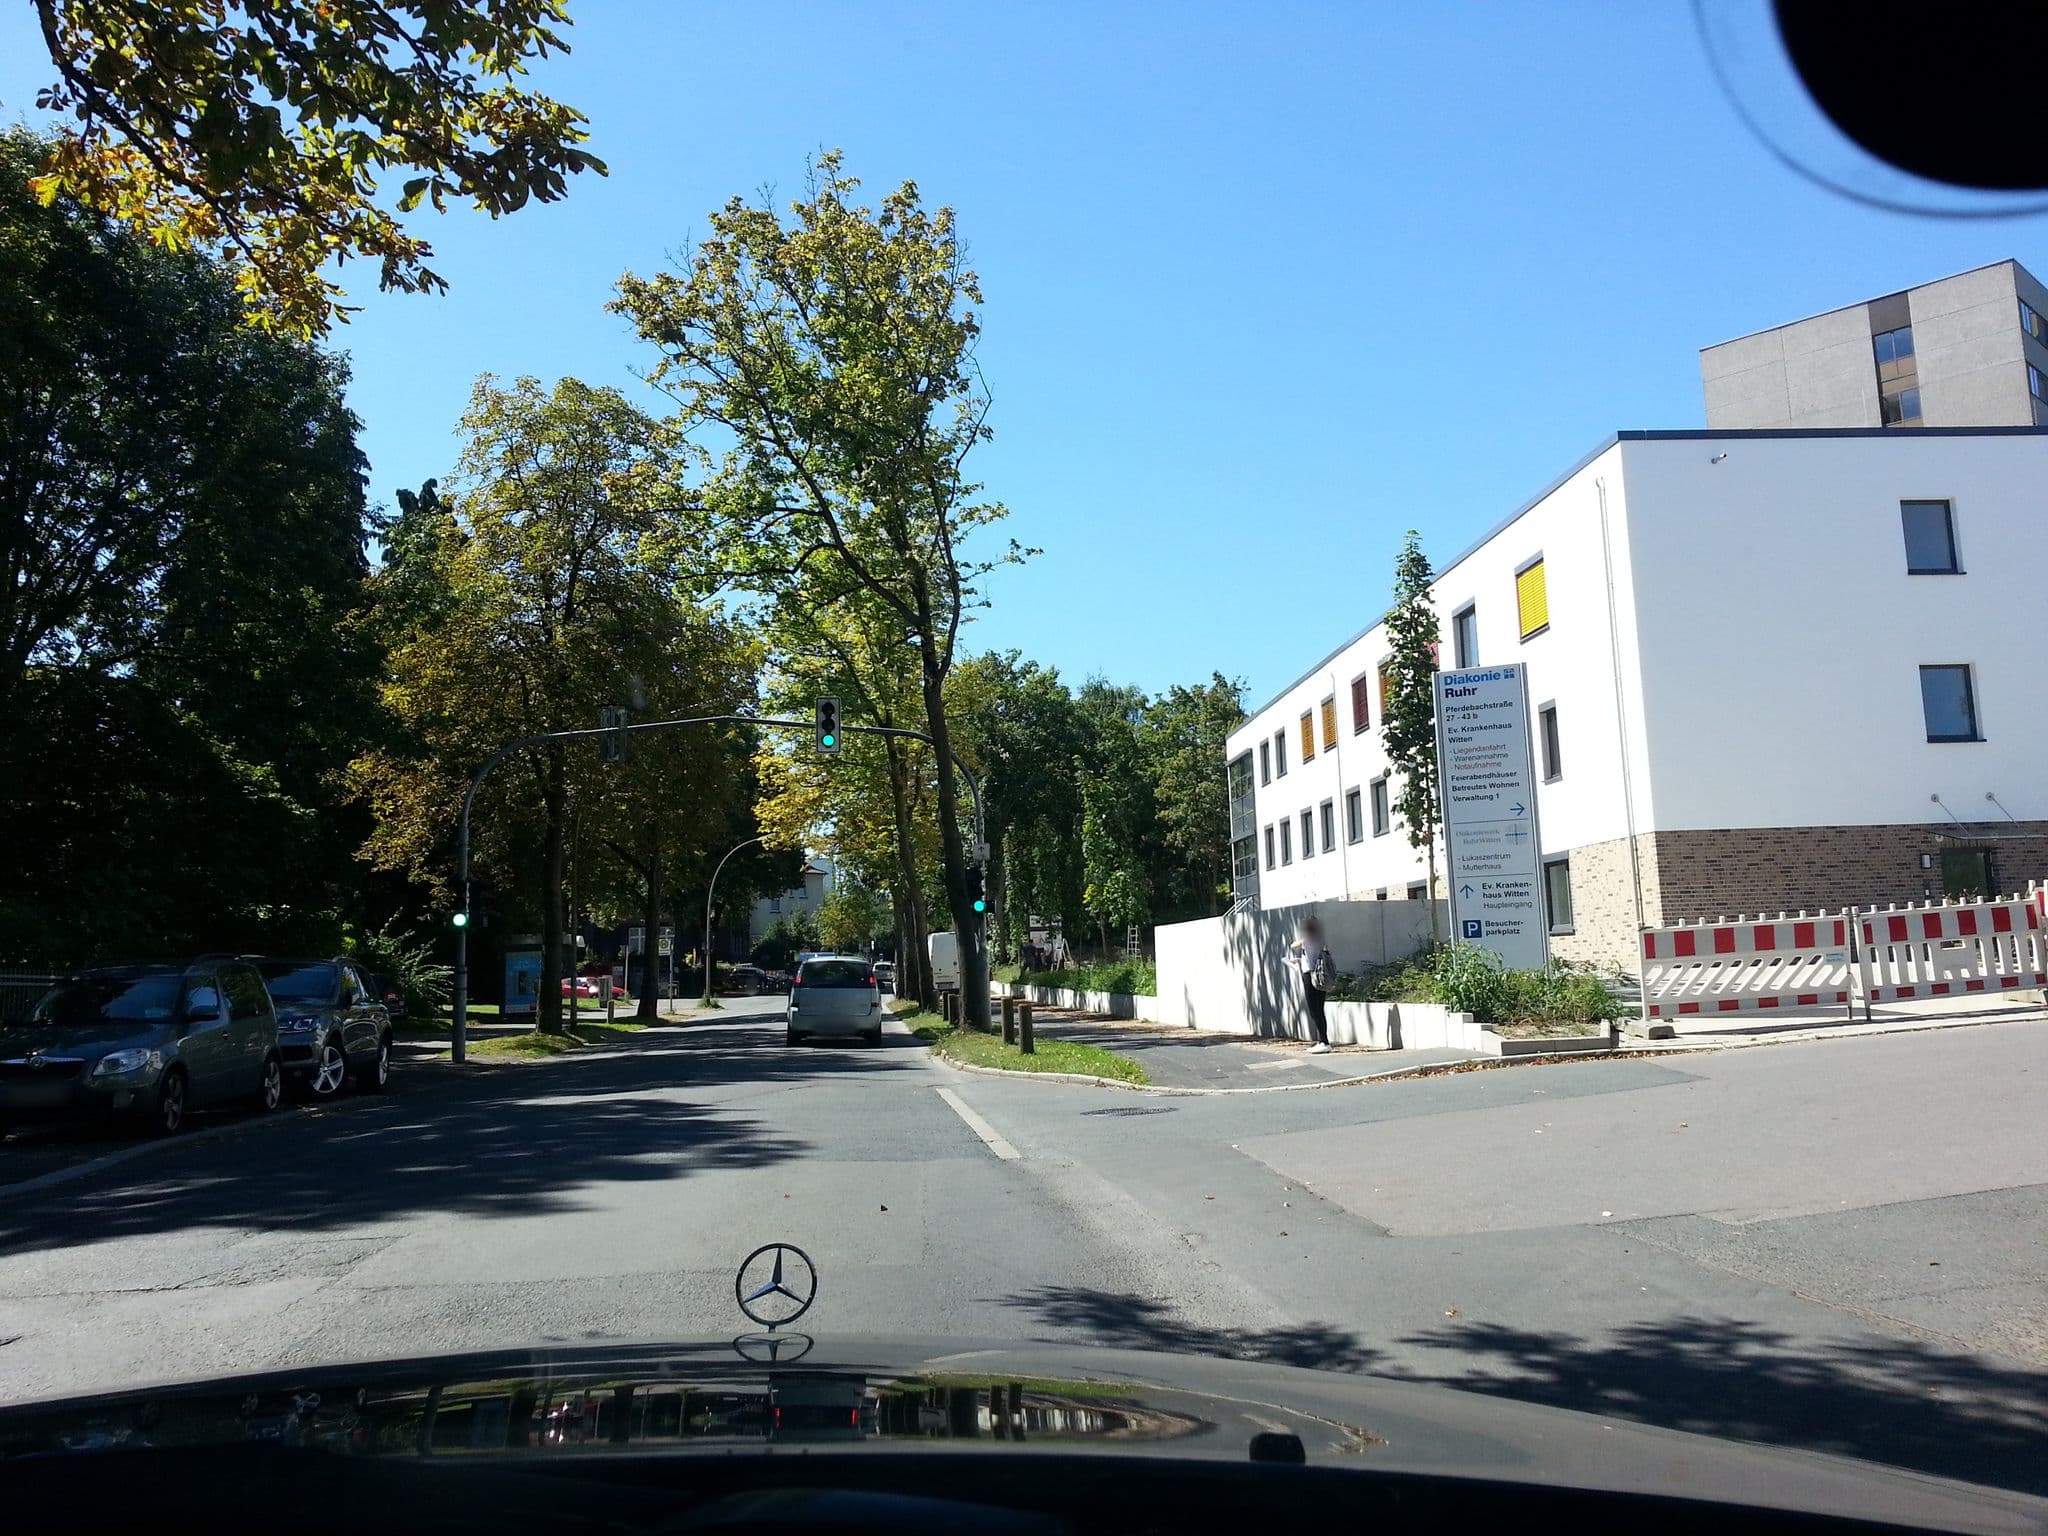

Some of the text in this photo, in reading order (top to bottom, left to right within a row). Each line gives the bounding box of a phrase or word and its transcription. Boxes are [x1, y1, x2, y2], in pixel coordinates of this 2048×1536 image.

[1444, 671, 1501, 685] Diakonie
[1445, 687, 1478, 698] Ruhr
[1446, 701, 1513, 713] Pferdebachstraße
[1461, 722, 1512, 732] Krankenhaus
[1455, 753, 1508, 762] Warenannahme
[1454, 761, 1501, 770] Notaufnahme
[1451, 771, 1517, 781] Feierabendhäuser
[1452, 781, 1520, 792] Betreutes Wohnen
[1453, 794, 1493, 802] Verwaltung
[1462, 853, 1511, 861] Lukaszentrum
[1496, 881, 1532, 889] Kranken-
[1483, 901, 1533, 909] Haupteingang
[1485, 928, 1521, 936] parkplatz
